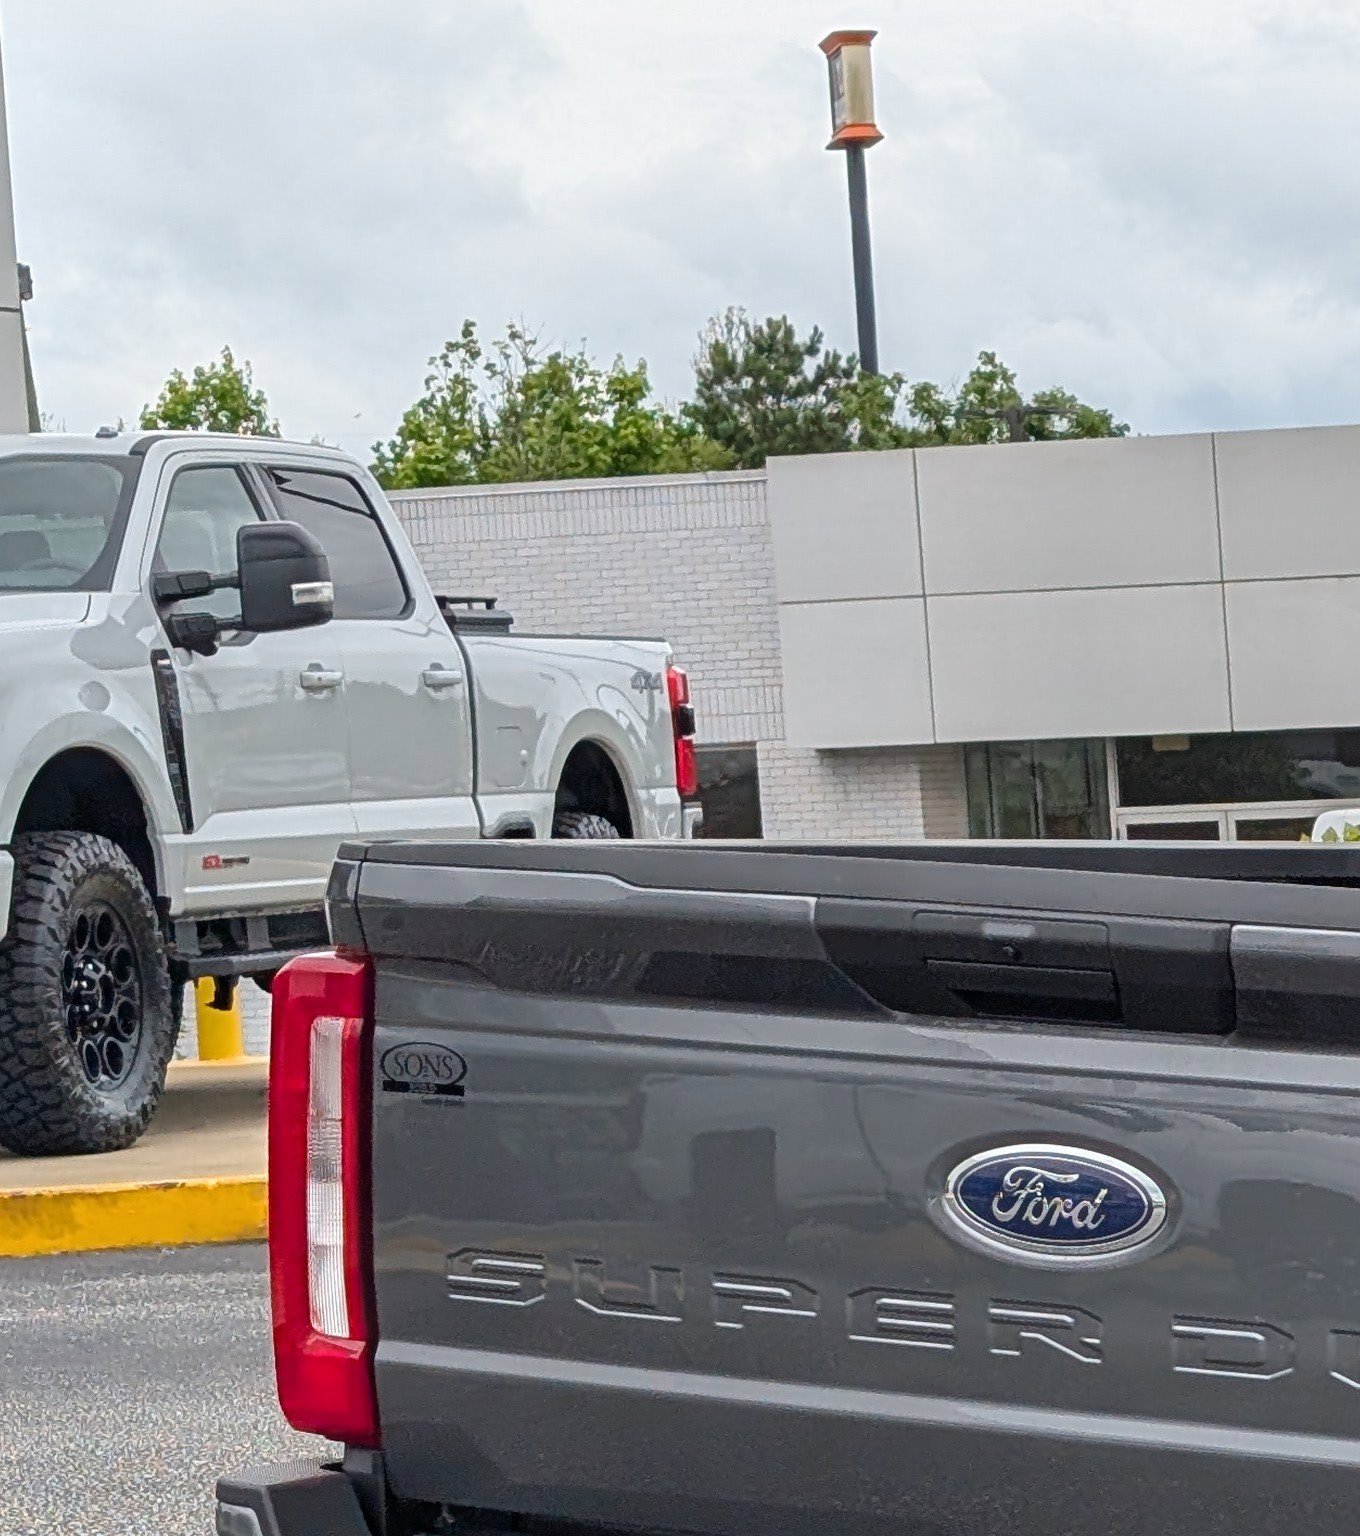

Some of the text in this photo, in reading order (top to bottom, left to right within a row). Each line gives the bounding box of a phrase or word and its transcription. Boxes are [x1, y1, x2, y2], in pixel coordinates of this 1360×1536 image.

[394, 1051, 452, 1080] SONS
[992, 1165, 1108, 1230] Ford
[445, 1245, 1103, 1365] SUPER
